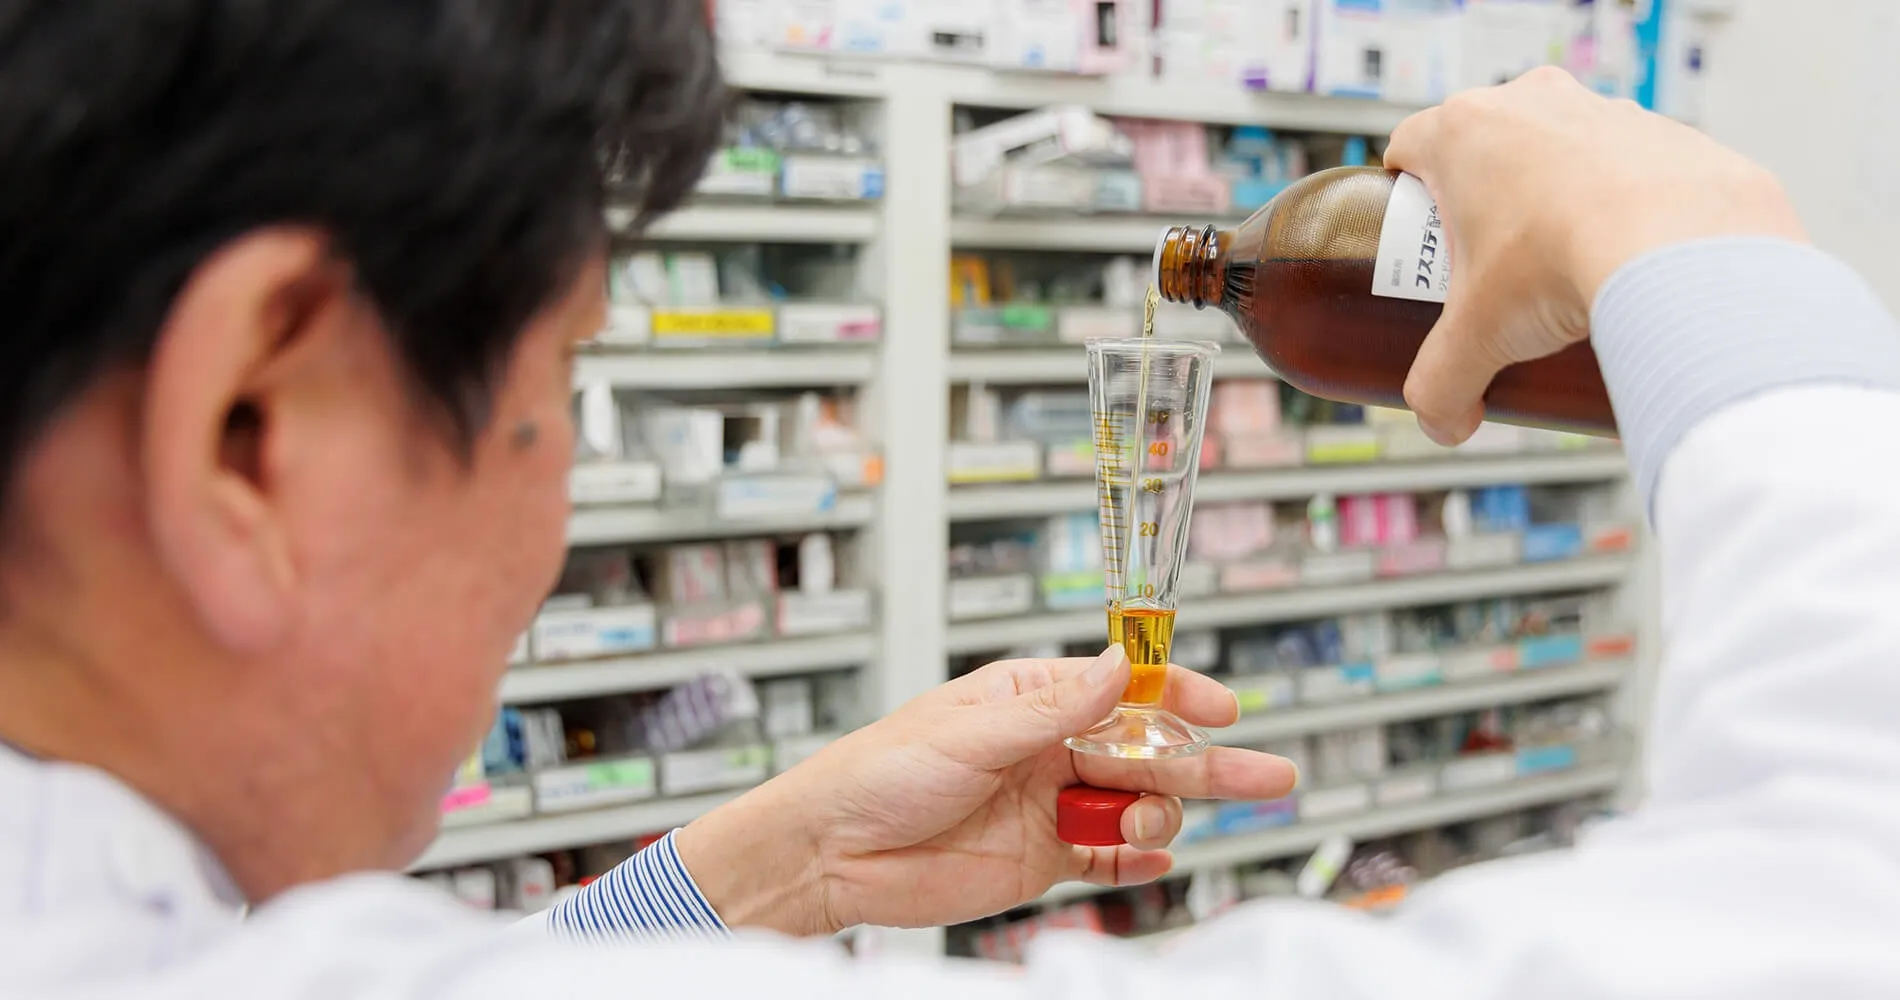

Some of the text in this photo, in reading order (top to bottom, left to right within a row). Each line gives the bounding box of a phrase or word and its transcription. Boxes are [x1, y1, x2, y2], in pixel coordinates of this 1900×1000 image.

[1147, 409, 1169, 424] 50
[1148, 442, 1168, 457] 40
[1143, 478, 1163, 492] 30
[1139, 522, 1158, 537] 20
[1137, 583, 1154, 598] 10
